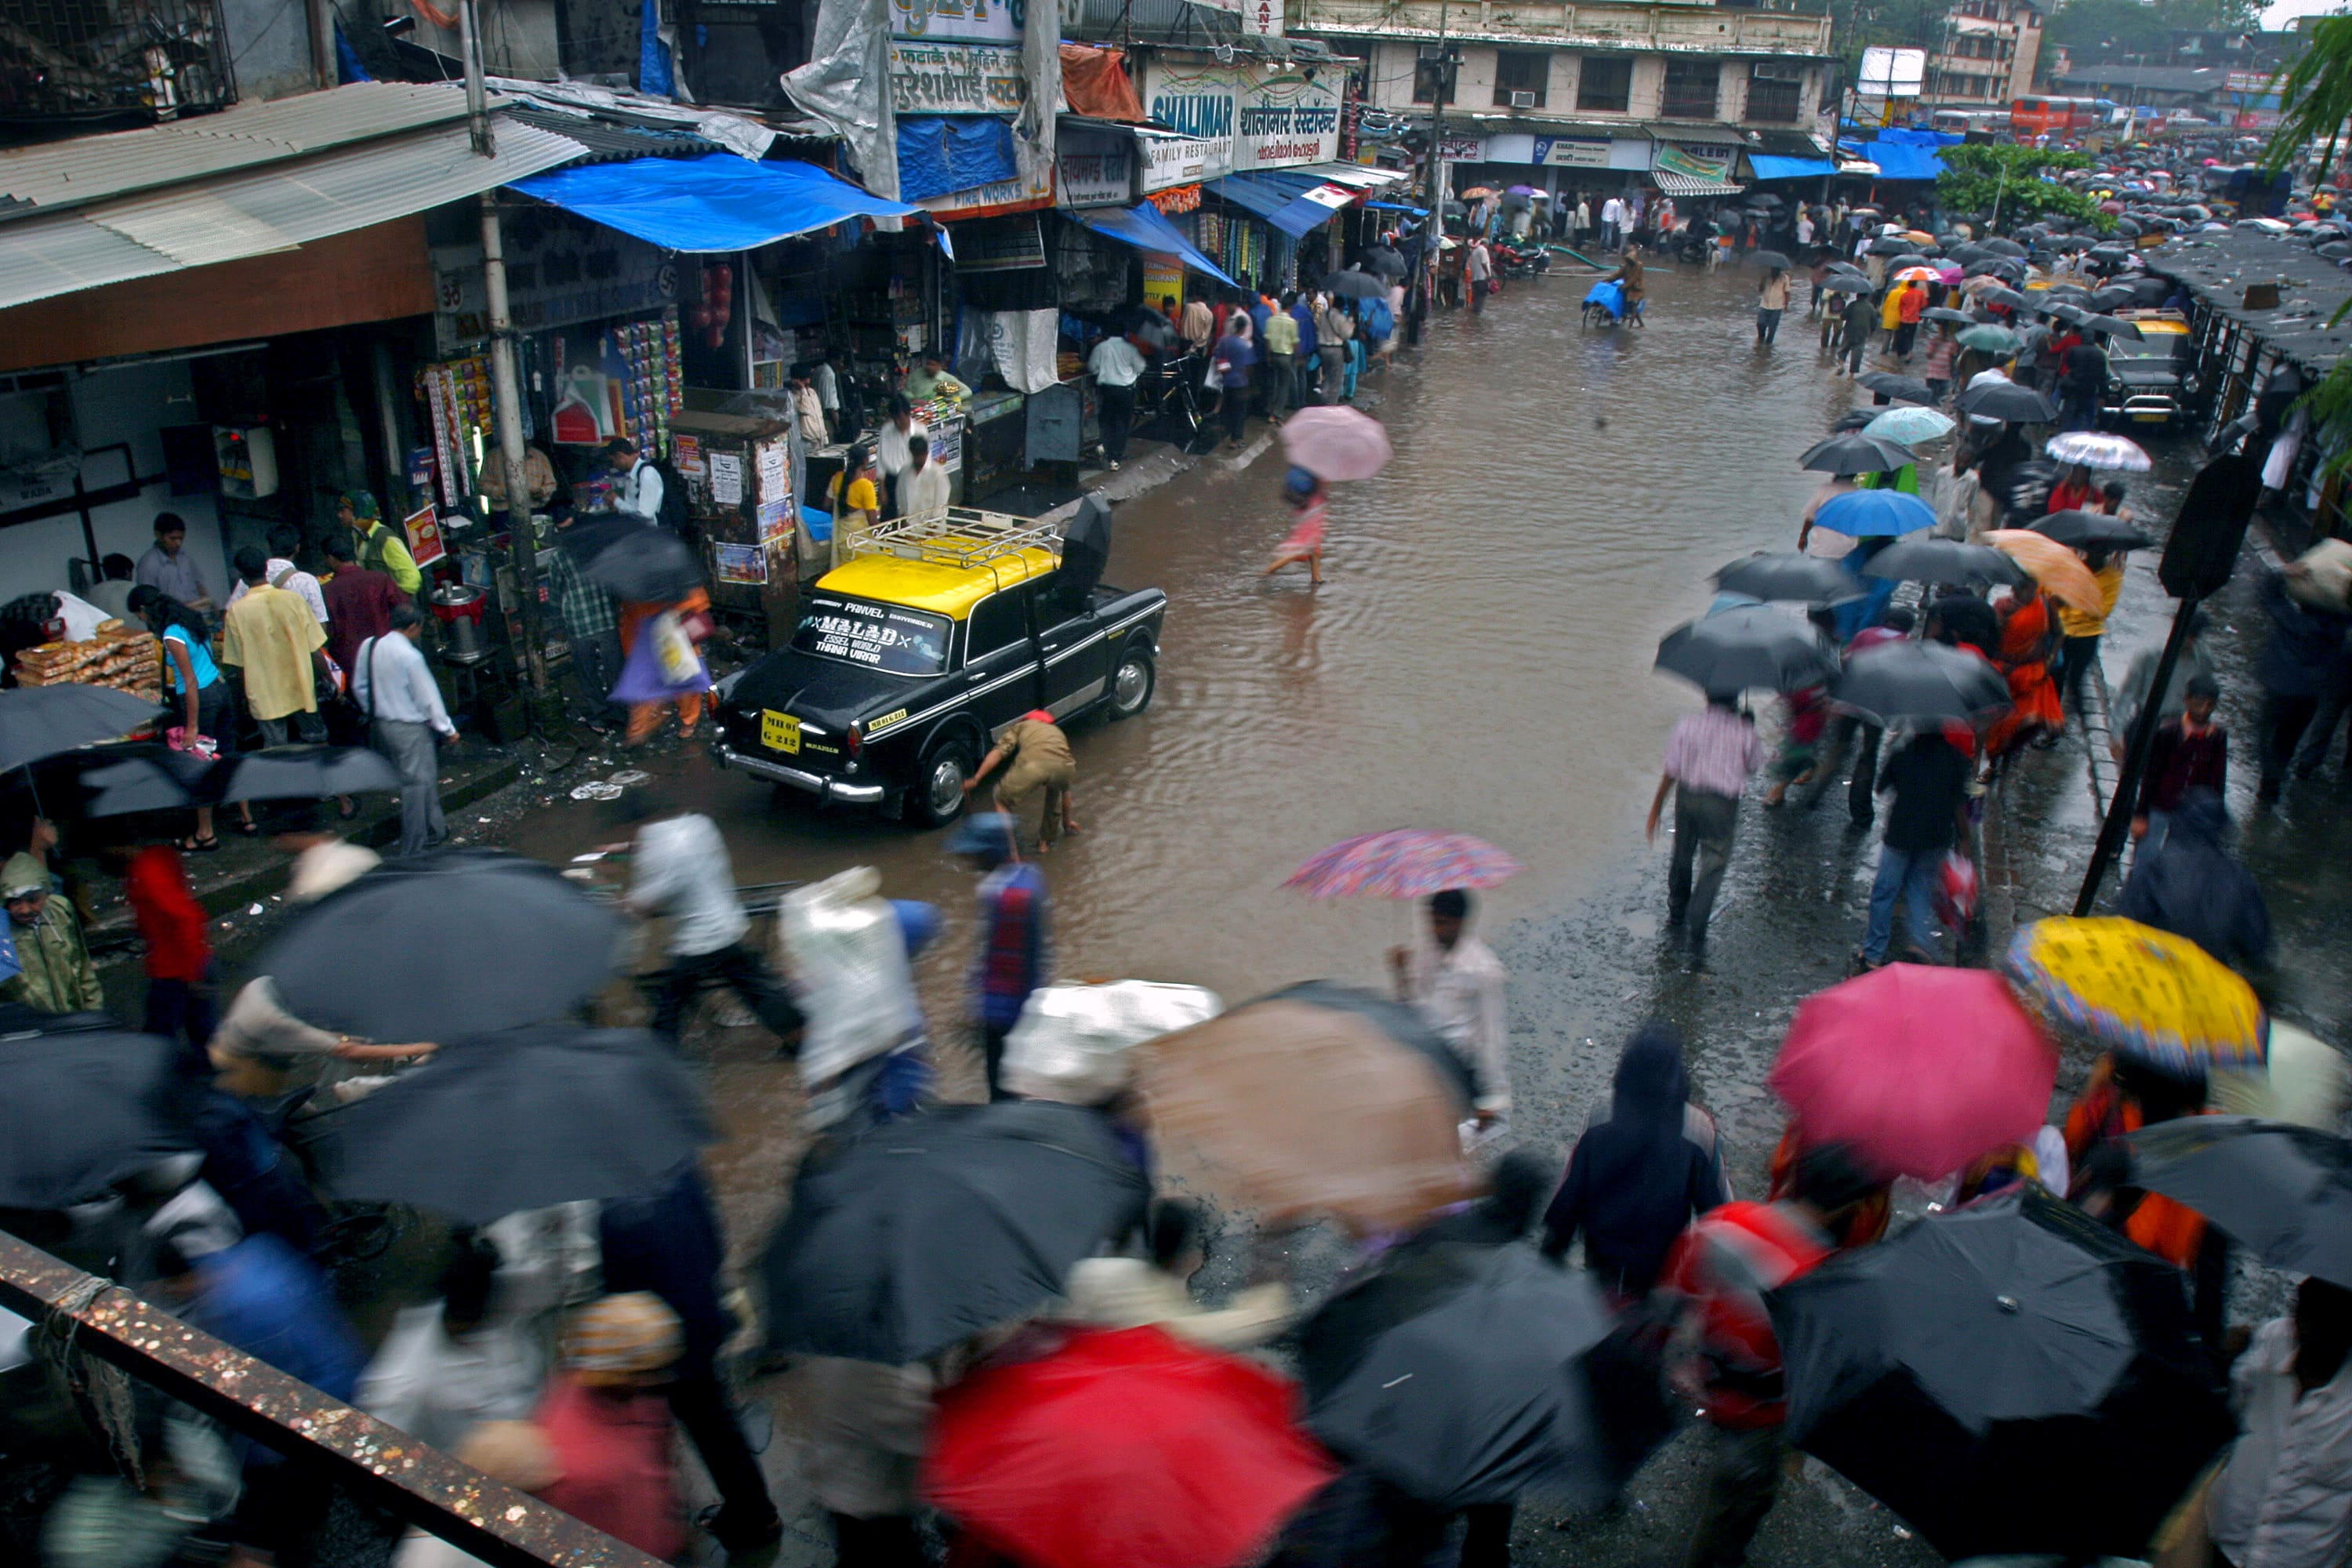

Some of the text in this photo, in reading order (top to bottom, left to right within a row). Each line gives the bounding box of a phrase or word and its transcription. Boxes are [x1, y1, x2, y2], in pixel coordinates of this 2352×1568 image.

[1152, 94, 1233, 144] SHALIMAR
[1150, 140, 1232, 164] FAMILY RESTAURANT
[954, 182, 1023, 209] FIRE WORKS
[844, 602, 885, 619] PANVEL
[818, 615, 898, 646] MALAD
[815, 641, 881, 665] THANA VIRAR
[824, 633, 881, 654] ESSEL WORLD
[765, 717, 797, 732] MH 01
[764, 731, 797, 747] G 212
